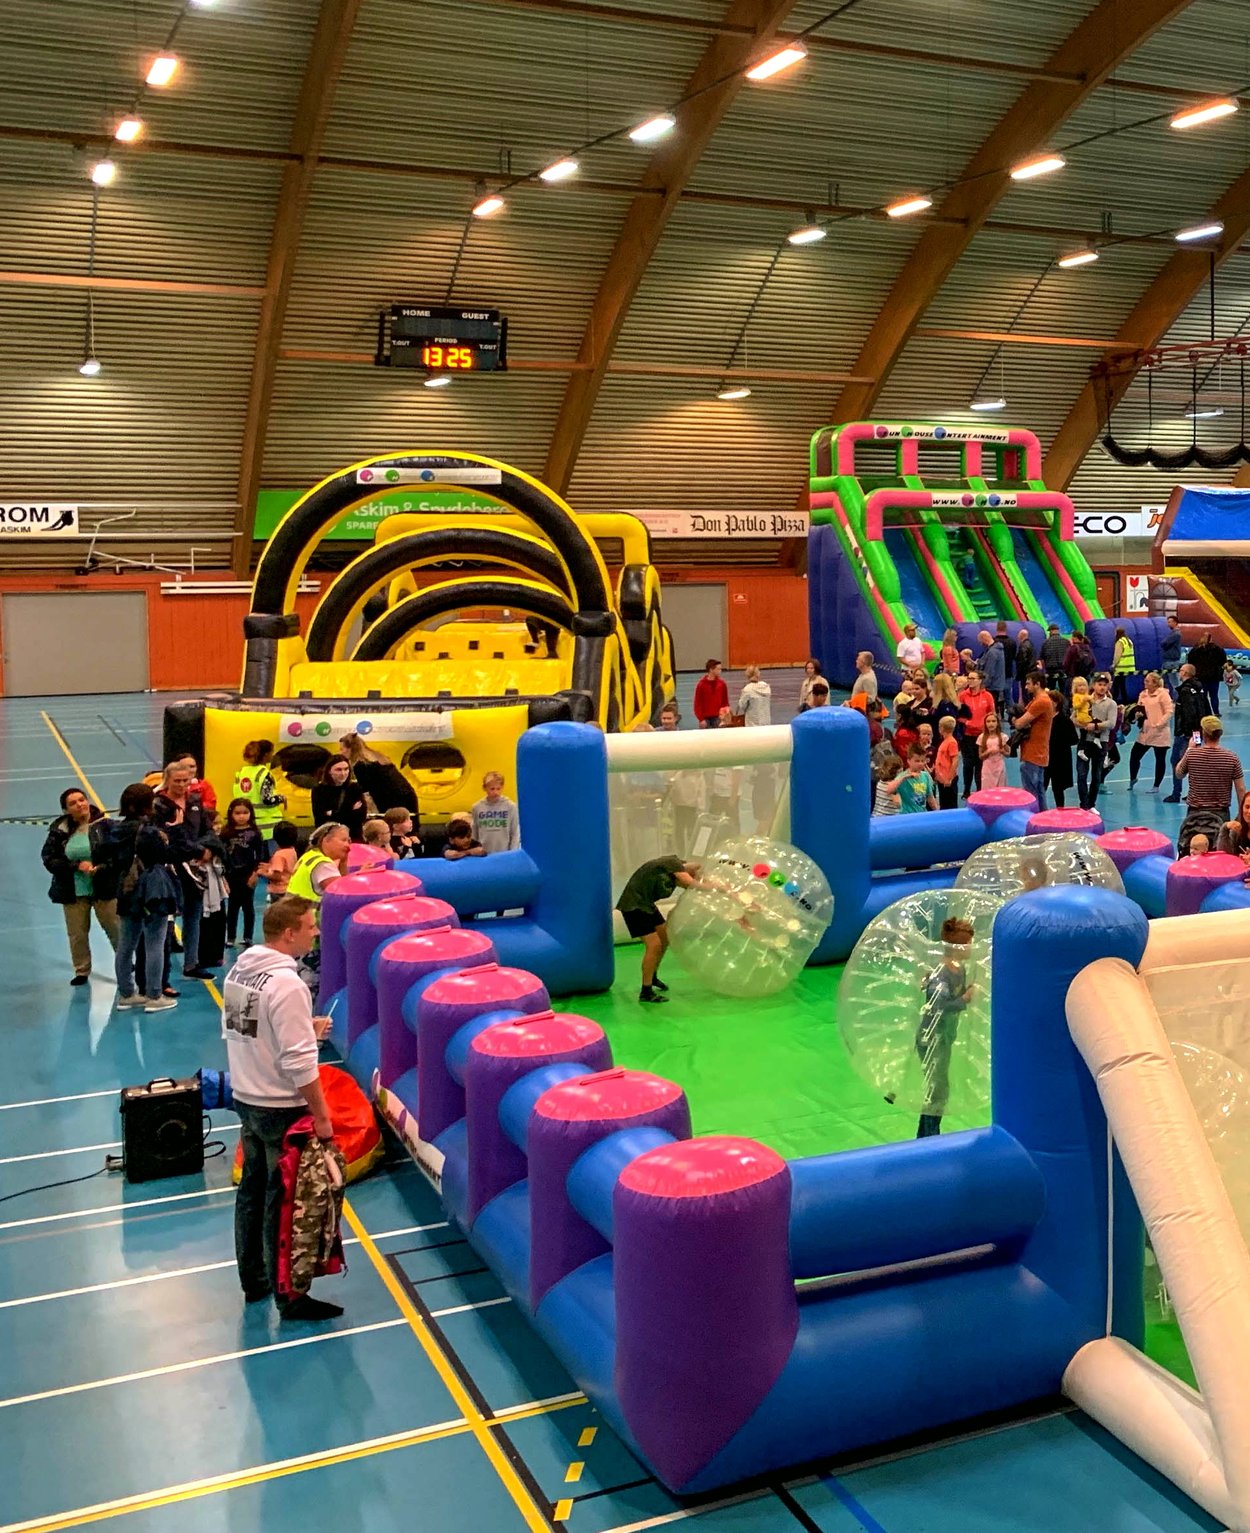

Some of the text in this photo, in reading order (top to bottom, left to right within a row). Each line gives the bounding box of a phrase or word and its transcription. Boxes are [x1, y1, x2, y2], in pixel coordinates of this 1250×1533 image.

[402, 309, 490, 320] HOME GUEST
[354, 502, 399, 516] skim
[690, 515, 721, 532] Don
[725, 514, 767, 535] Pablo
[771, 514, 805, 535] Pizza
[479, 811, 508, 819] GAME
